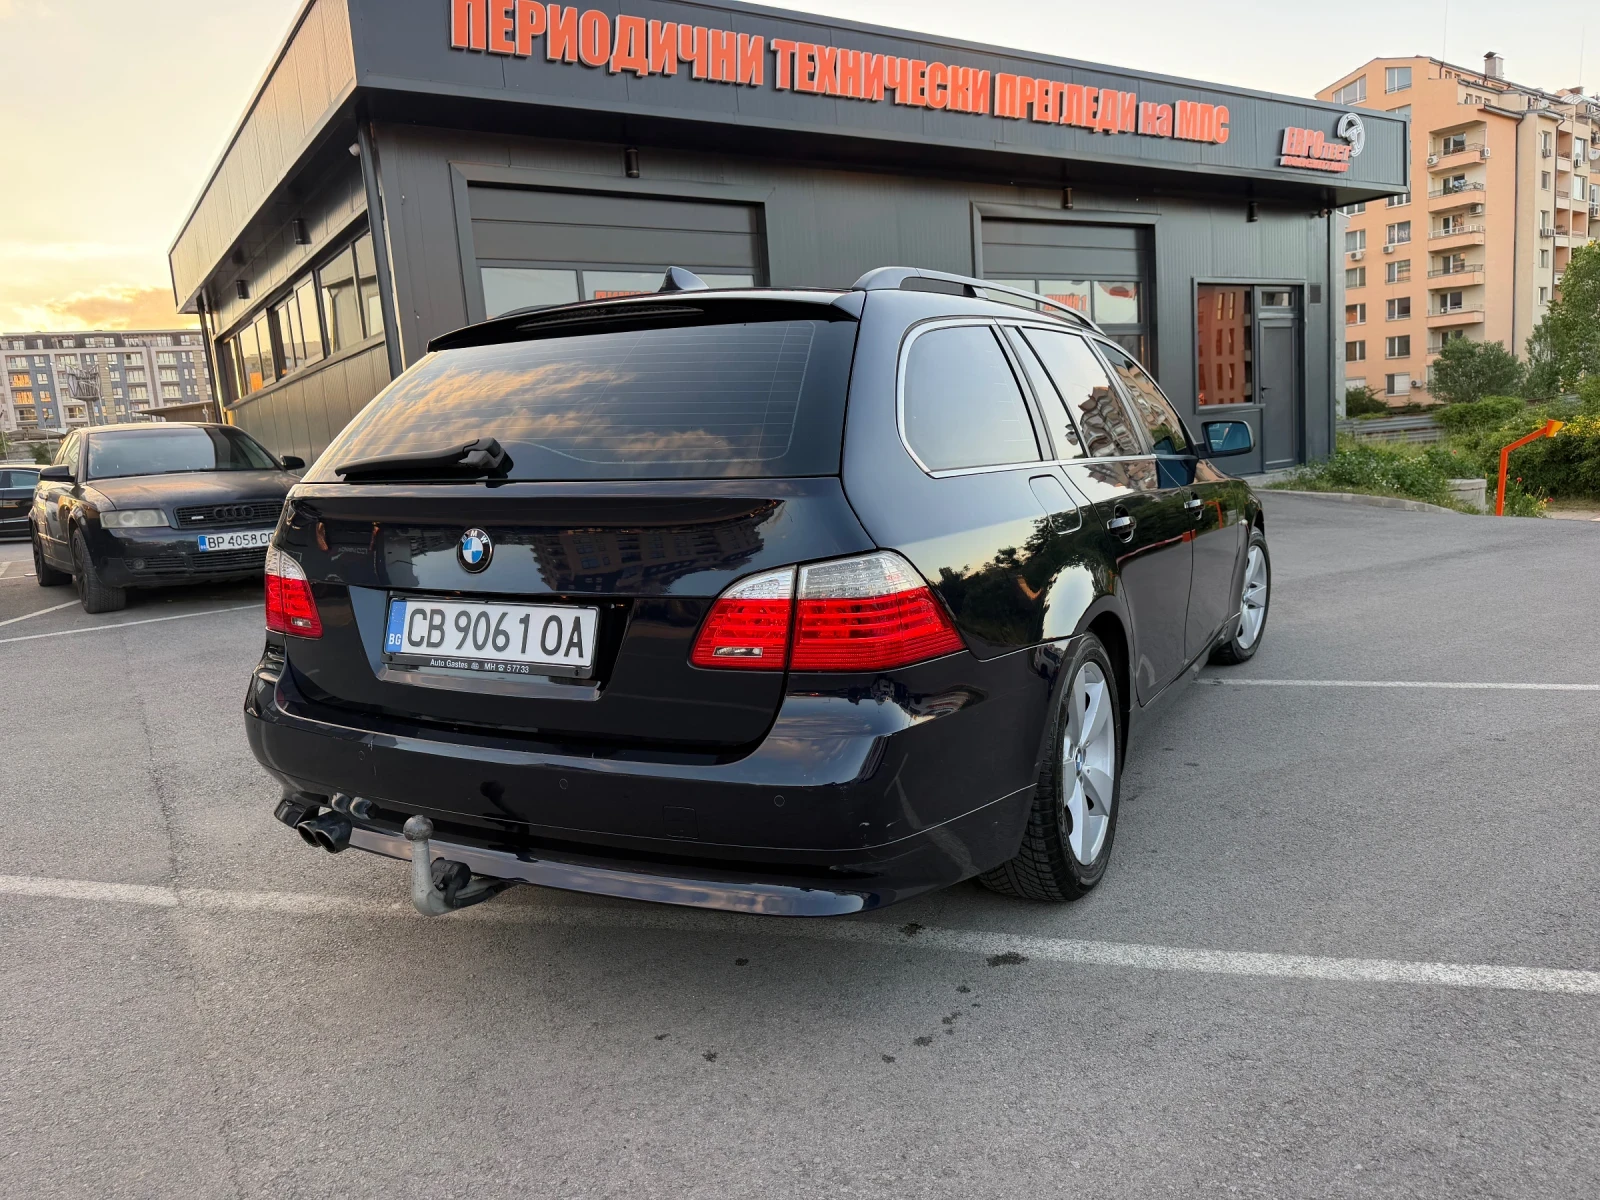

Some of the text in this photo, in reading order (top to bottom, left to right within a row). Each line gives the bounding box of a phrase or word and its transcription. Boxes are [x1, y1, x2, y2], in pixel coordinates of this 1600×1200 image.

[451, 0, 1230, 144] ПЕРИОДИЧНИ ТЕХНИЧЕСКИ ПРЕГЛЕДИ на МПС
[207, 535, 225, 549] BP
[227, 533, 258, 547] 4058
[461, 529, 489, 544] BMW
[388, 633, 402, 646] BG
[407, 608, 584, 658] CB 9061 OA
[430, 658, 445, 668] Auto
[446, 659, 468, 669] Gastes
[507, 665, 530, 674] 57733
